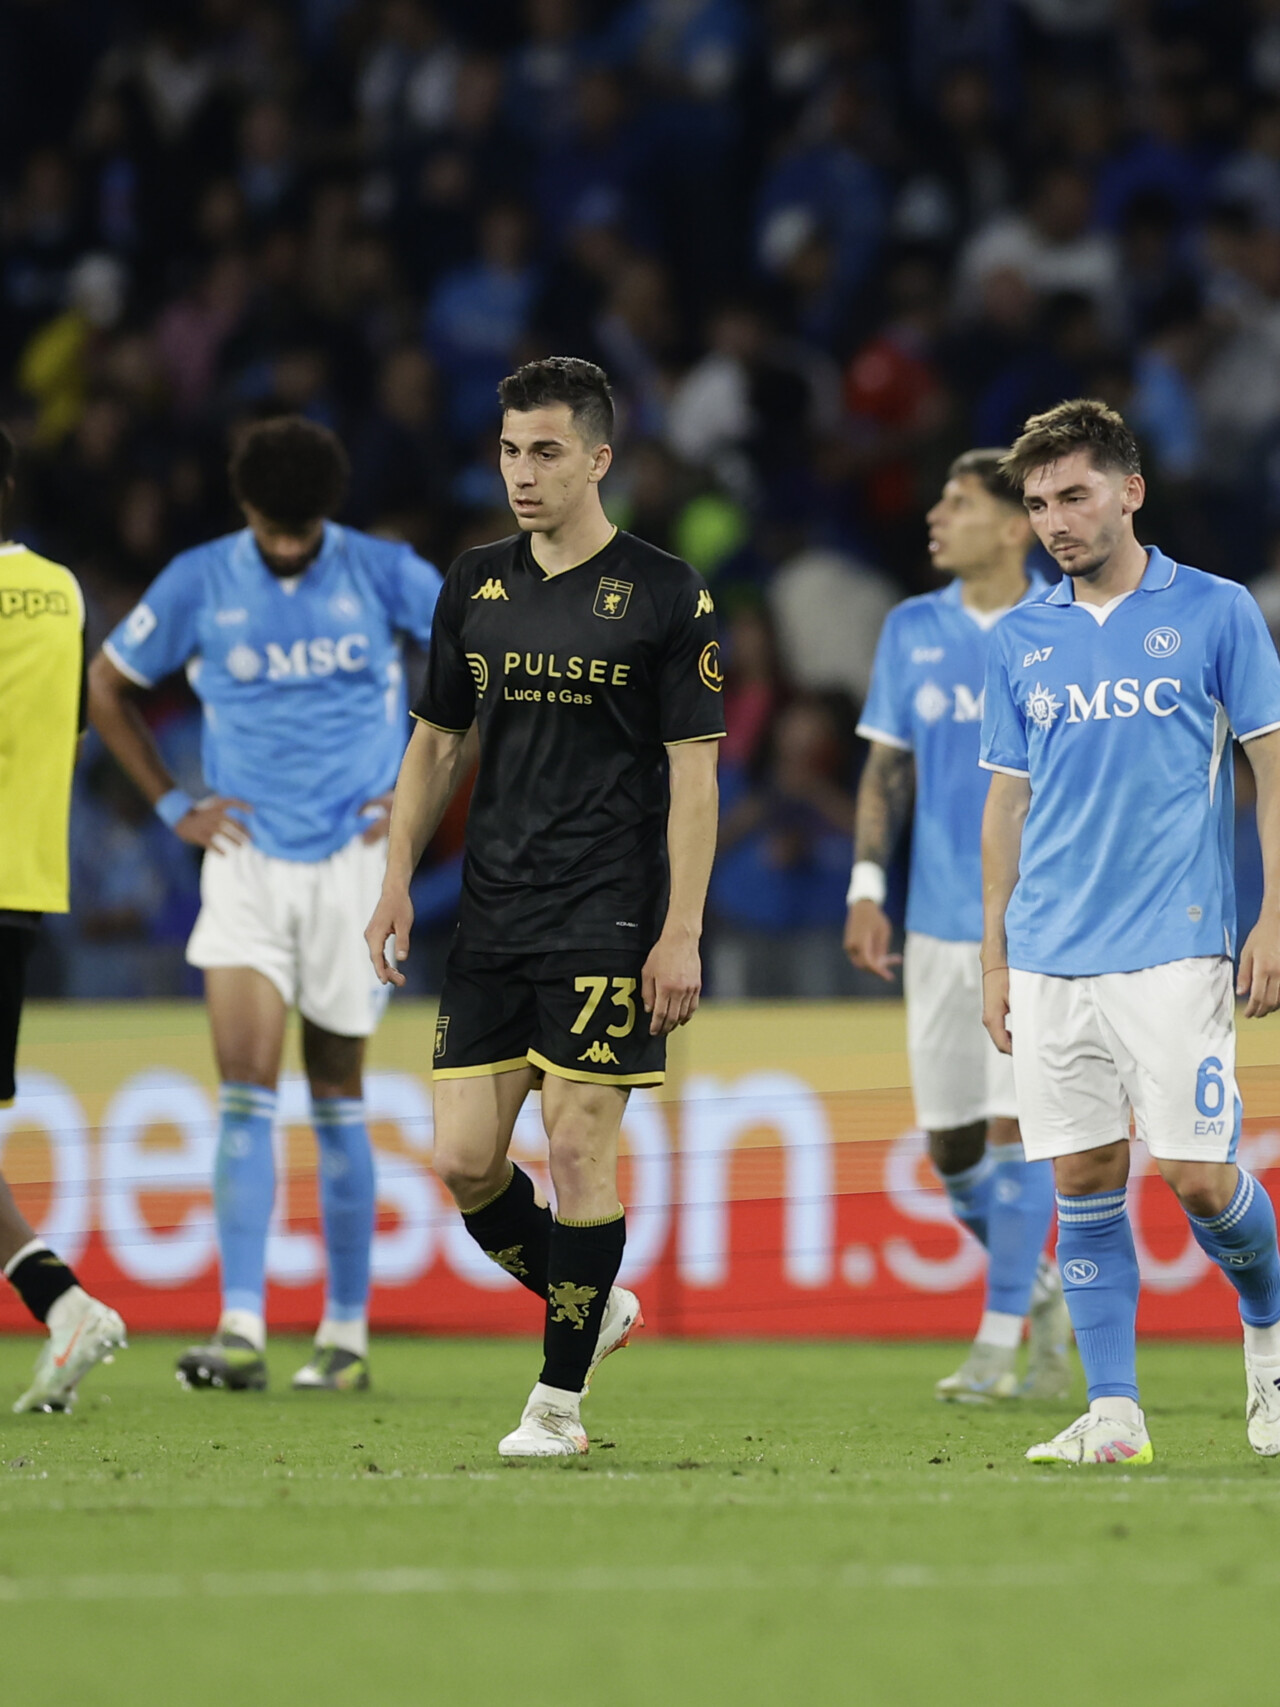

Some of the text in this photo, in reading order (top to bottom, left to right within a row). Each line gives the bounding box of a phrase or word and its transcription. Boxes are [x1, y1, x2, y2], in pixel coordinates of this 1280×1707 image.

[266, 633, 369, 681] MSC
[504, 652, 631, 686] PULSEE
[1022, 646, 1054, 668] EA7
[504, 687, 593, 704] Luce e Gas
[1064, 677, 1181, 724] MSC
[570, 976, 637, 1038] 73
[1195, 1055, 1225, 1118] 6
[1194, 1121, 1225, 1135] EA7
